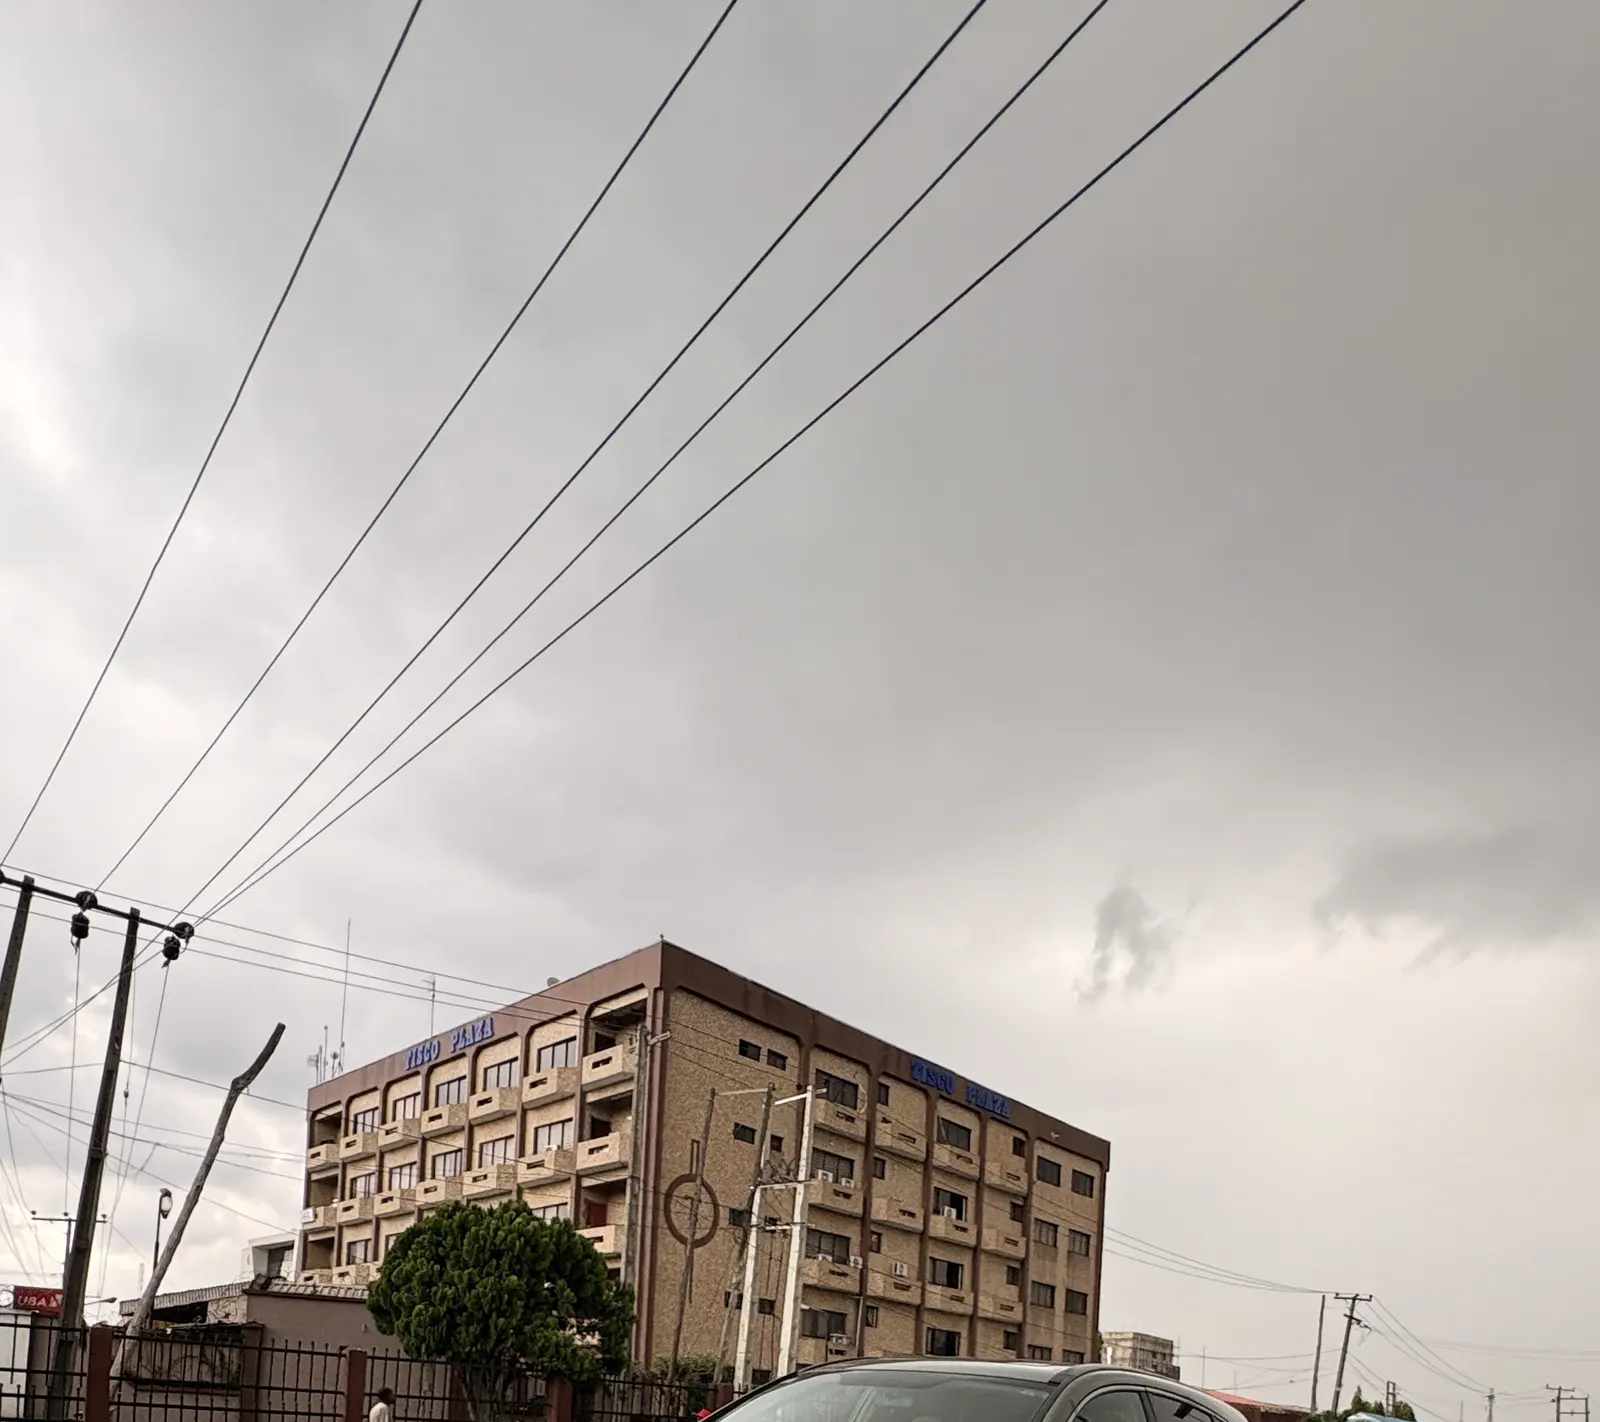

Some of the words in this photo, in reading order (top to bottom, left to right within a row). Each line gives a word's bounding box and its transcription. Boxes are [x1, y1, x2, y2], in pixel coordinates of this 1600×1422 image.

[449, 1016, 494, 1053] PLAZA
[965, 1081, 1011, 1119] PLAZA
[17, 1295, 47, 1307] UBA
